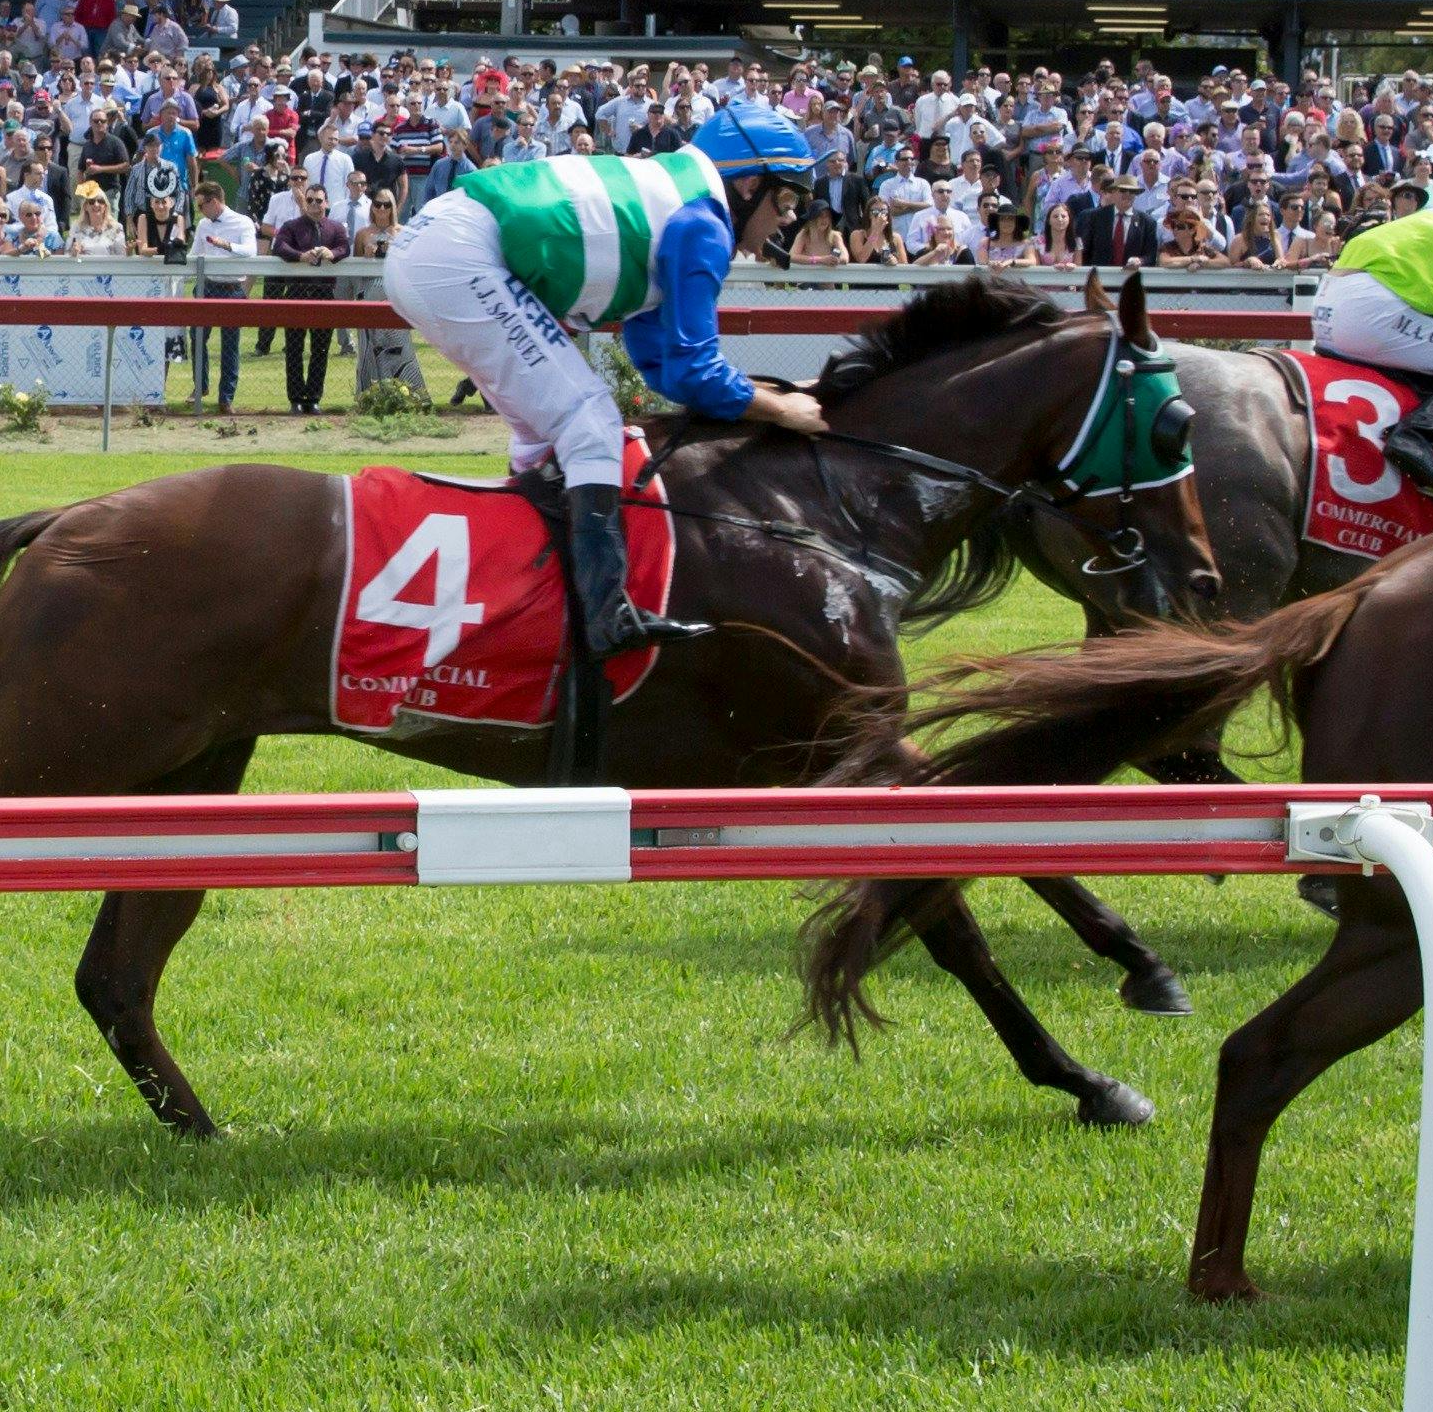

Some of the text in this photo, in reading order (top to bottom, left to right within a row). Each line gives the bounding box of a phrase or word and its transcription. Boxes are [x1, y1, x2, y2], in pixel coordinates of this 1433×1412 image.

[1323, 378, 1403, 504] 3
[355, 512, 485, 668] 4
[1337, 528, 1384, 552] CLUB
